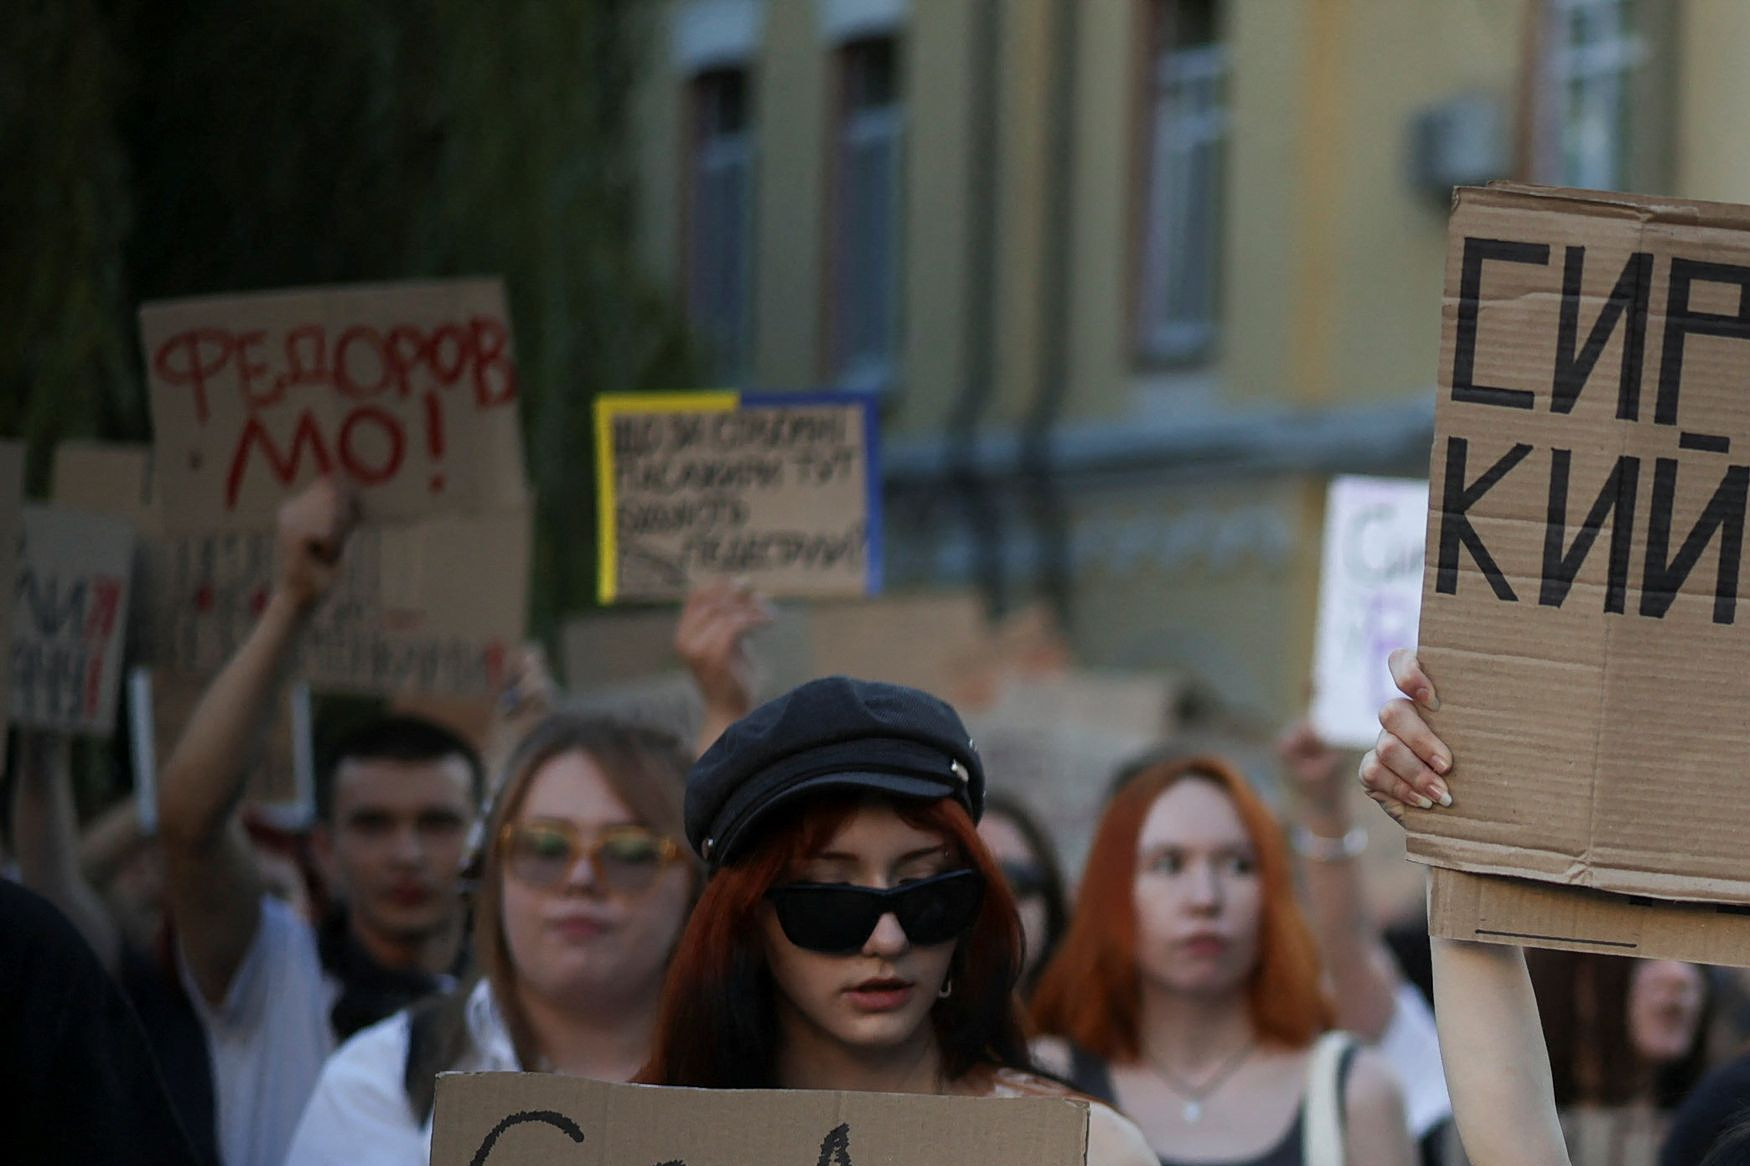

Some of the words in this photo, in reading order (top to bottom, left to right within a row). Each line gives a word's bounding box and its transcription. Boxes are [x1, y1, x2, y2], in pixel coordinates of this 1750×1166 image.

[153, 313, 517, 422] ФЕДОРОВ
[225, 389, 445, 512] МО!
[1434, 432, 1750, 626] КИЙ
